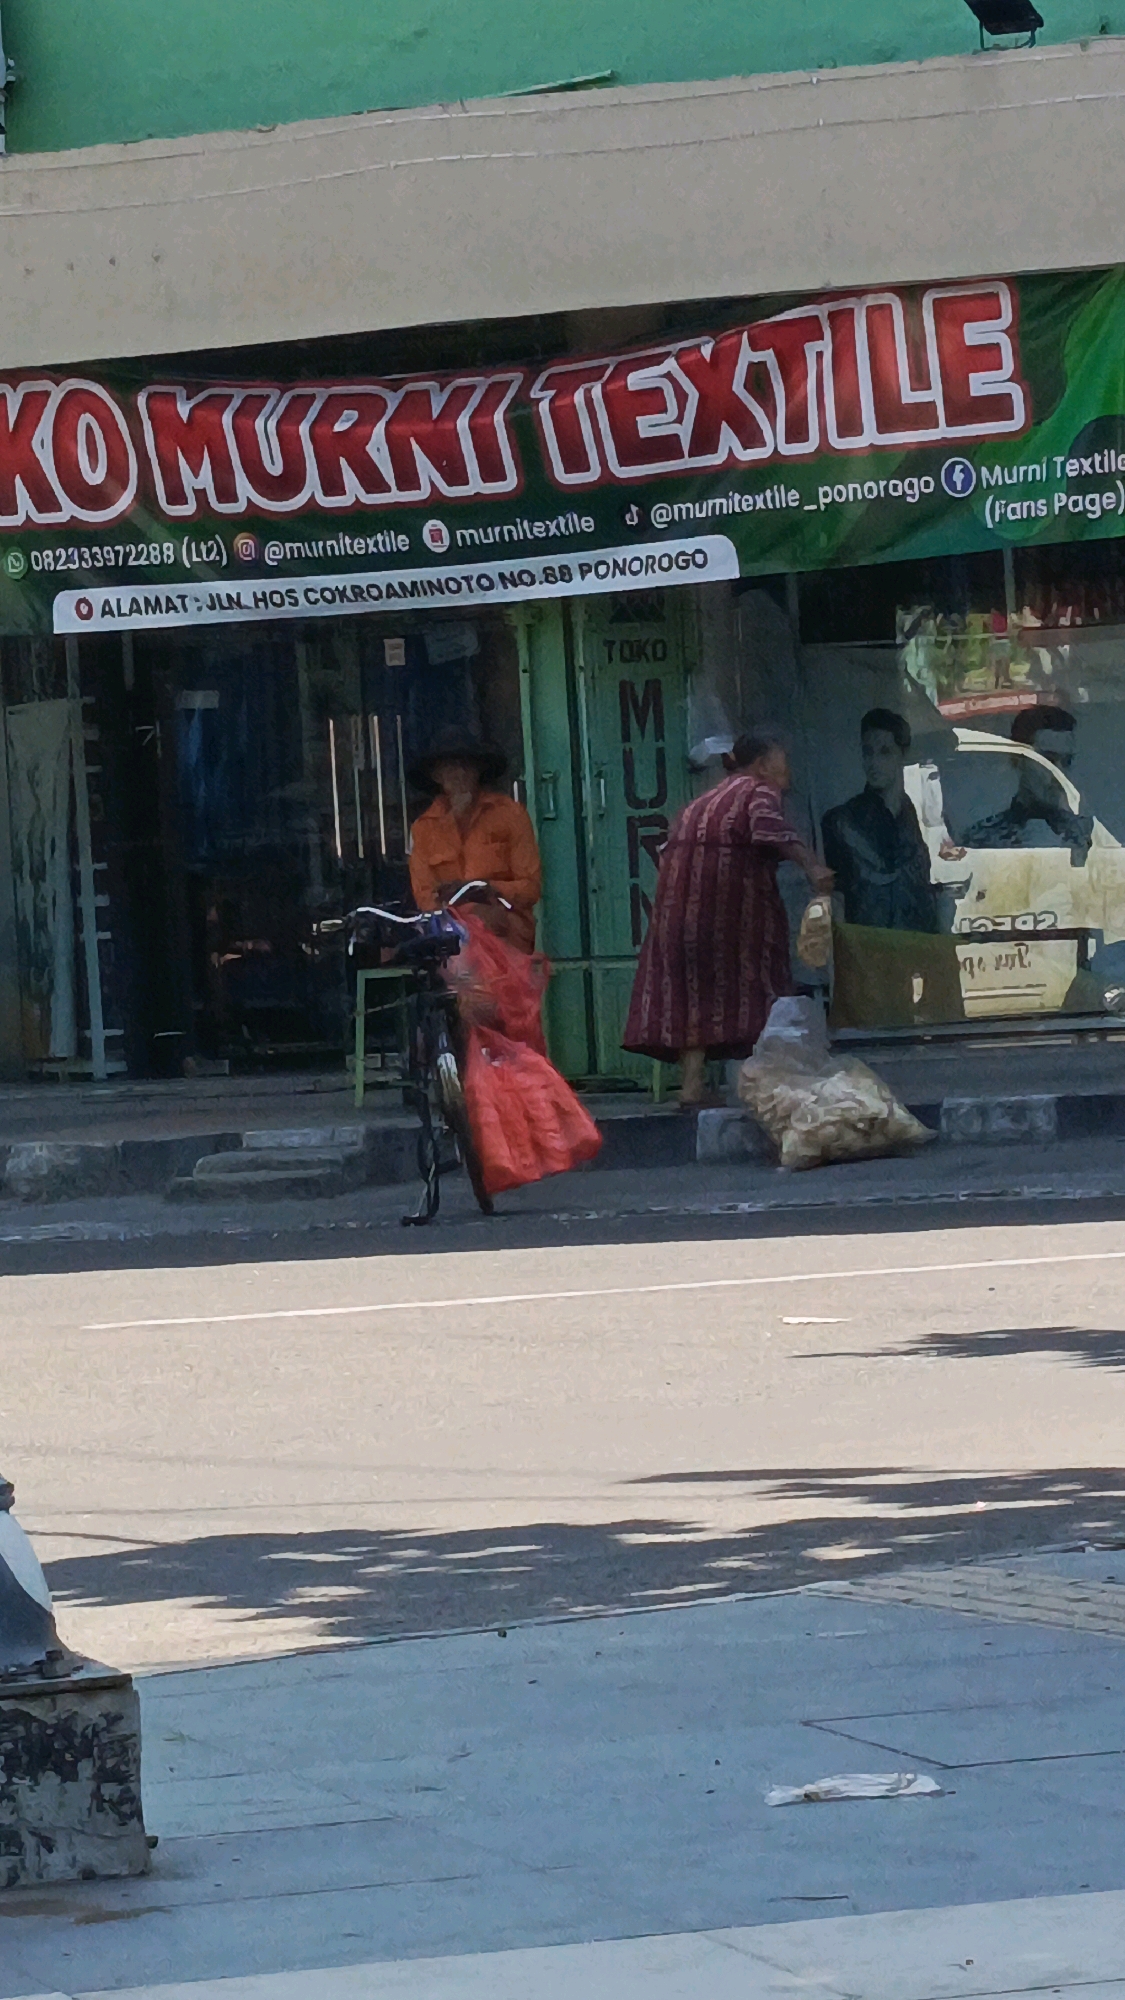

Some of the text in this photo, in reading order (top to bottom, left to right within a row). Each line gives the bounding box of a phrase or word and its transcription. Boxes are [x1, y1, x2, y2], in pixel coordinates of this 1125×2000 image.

[138, 373, 525, 514] MURNI
[531, 280, 1026, 484] TEXTILE
[981, 456, 1047, 490] Murni
[984, 479, 1125, 529] (Fans Page)
[264, 530, 410, 566] @murnitextile
[456, 511, 595, 547] murnitextile
[253, 588, 299, 610] HOS
[303, 573, 495, 605] COKROAMINOTO
[578, 548, 708, 581] PONOROGO
